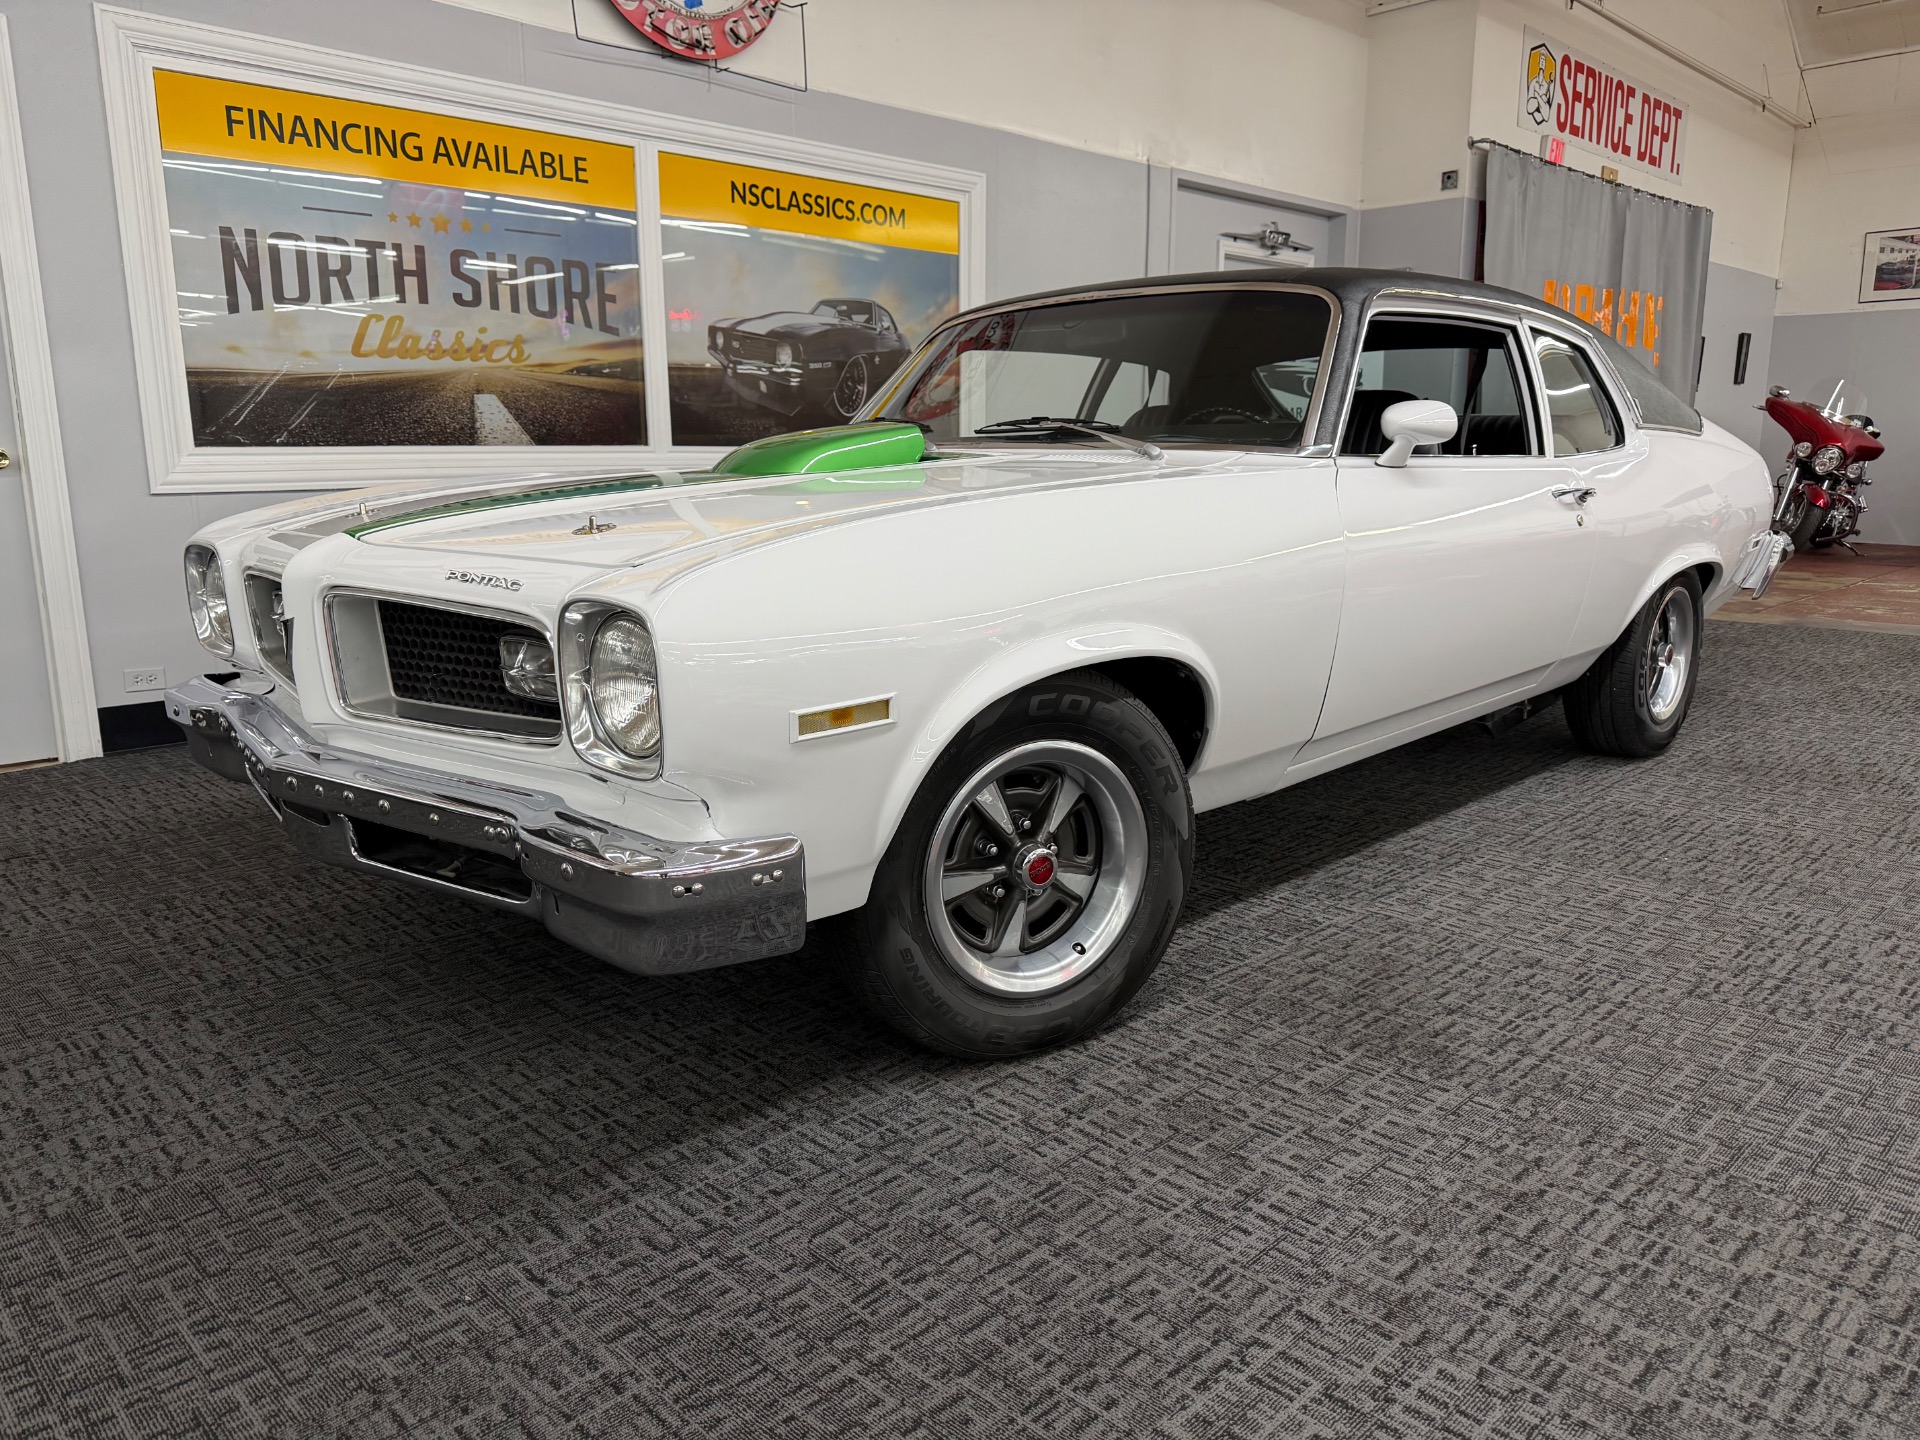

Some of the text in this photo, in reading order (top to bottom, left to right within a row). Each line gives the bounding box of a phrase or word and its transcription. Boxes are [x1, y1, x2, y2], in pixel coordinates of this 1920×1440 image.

[225, 105, 589, 184] FINANCING AVAILABLE
[1549, 137, 1566, 164] EXIT
[1556, 54, 1683, 176] SERVICE DEPT.
[730, 180, 906, 229] NSCLASSICS.COM
[218, 226, 620, 337] NORTH SHORE
[350, 313, 532, 365] Classics
[445, 569, 524, 592] PONTIAC
[1029, 693, 1179, 798] COOPER
[898, 946, 981, 1034] TOURING
